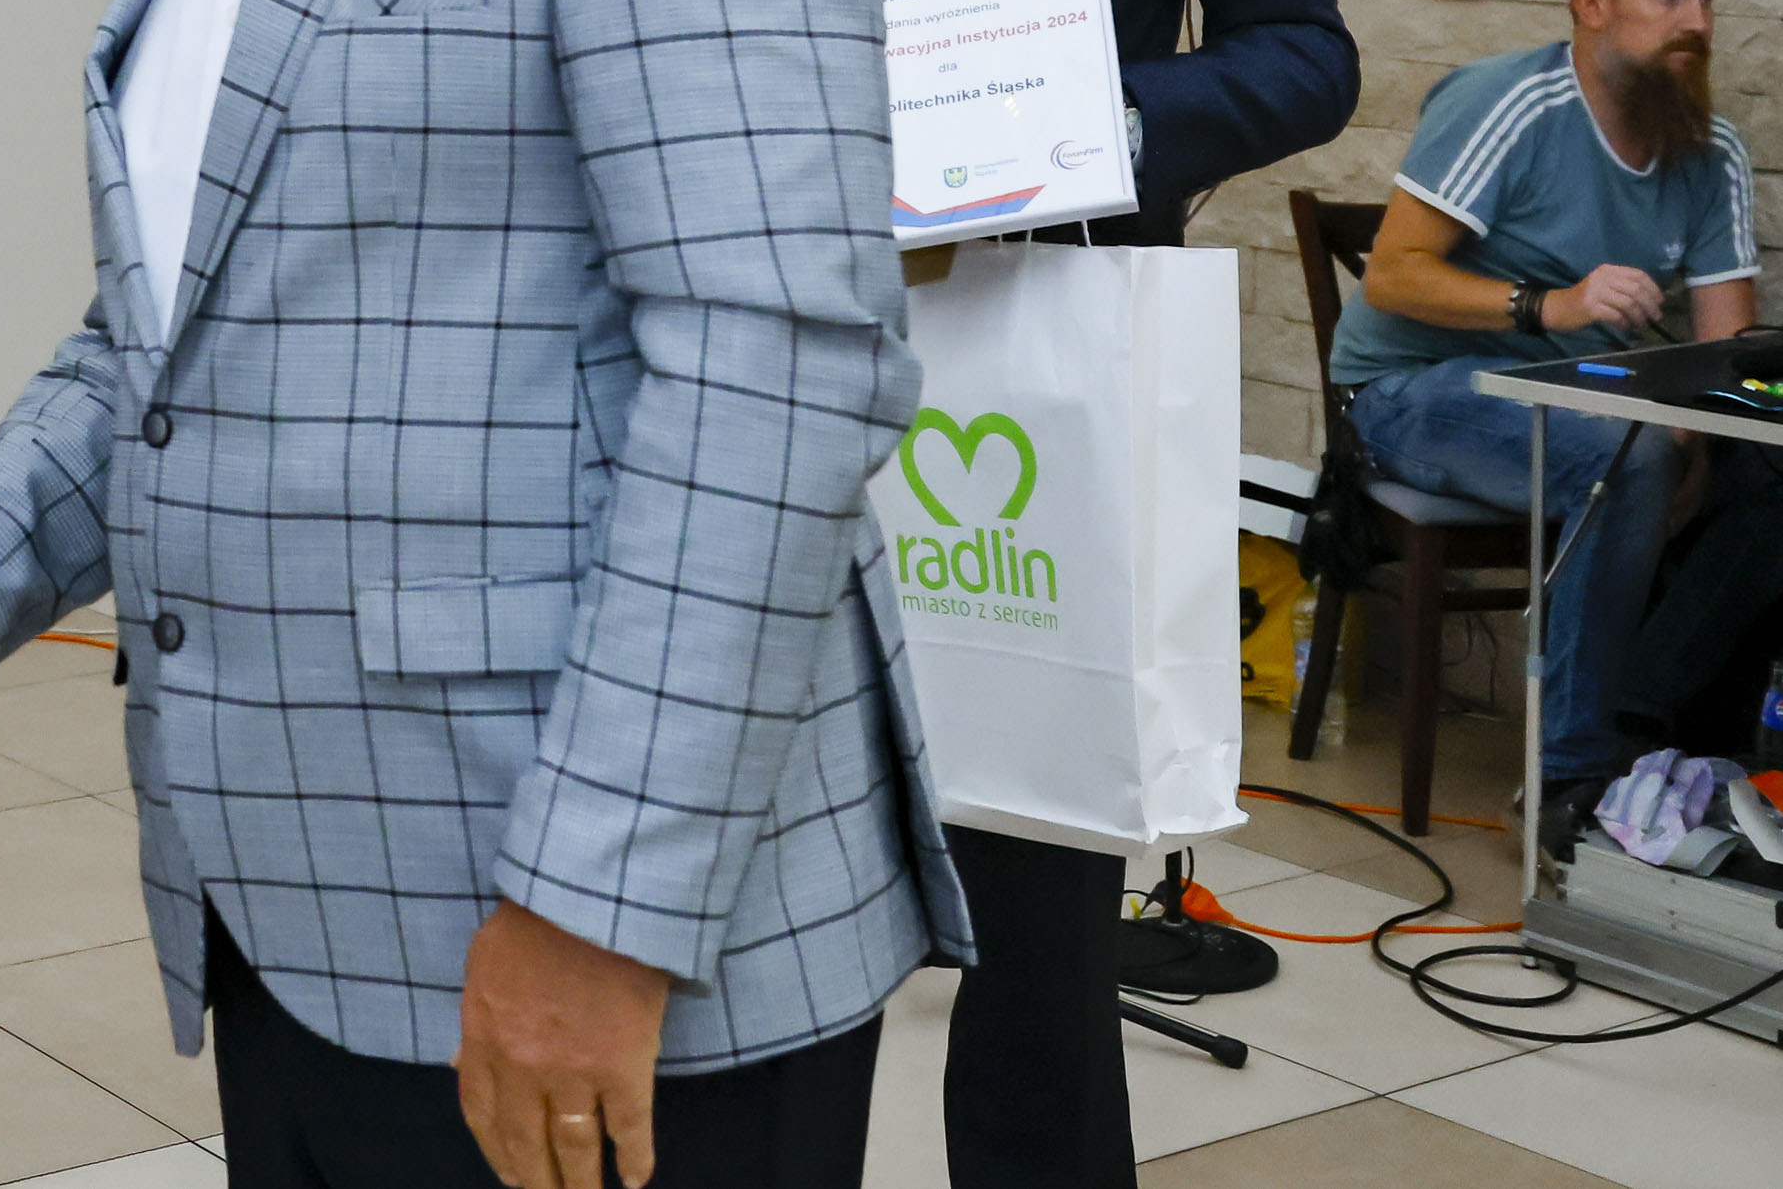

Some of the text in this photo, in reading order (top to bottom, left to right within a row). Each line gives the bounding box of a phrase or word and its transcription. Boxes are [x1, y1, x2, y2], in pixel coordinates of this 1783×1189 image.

[885, 18, 921, 30] dania
[885, 10, 1088, 59] wacyjna Instytucja 2024
[938, 62, 957, 73] dla
[889, 76, 1045, 114] olitechnika Śląska
[896, 526, 1057, 602] radlin
[902, 595, 1058, 631] miasto z sercem
